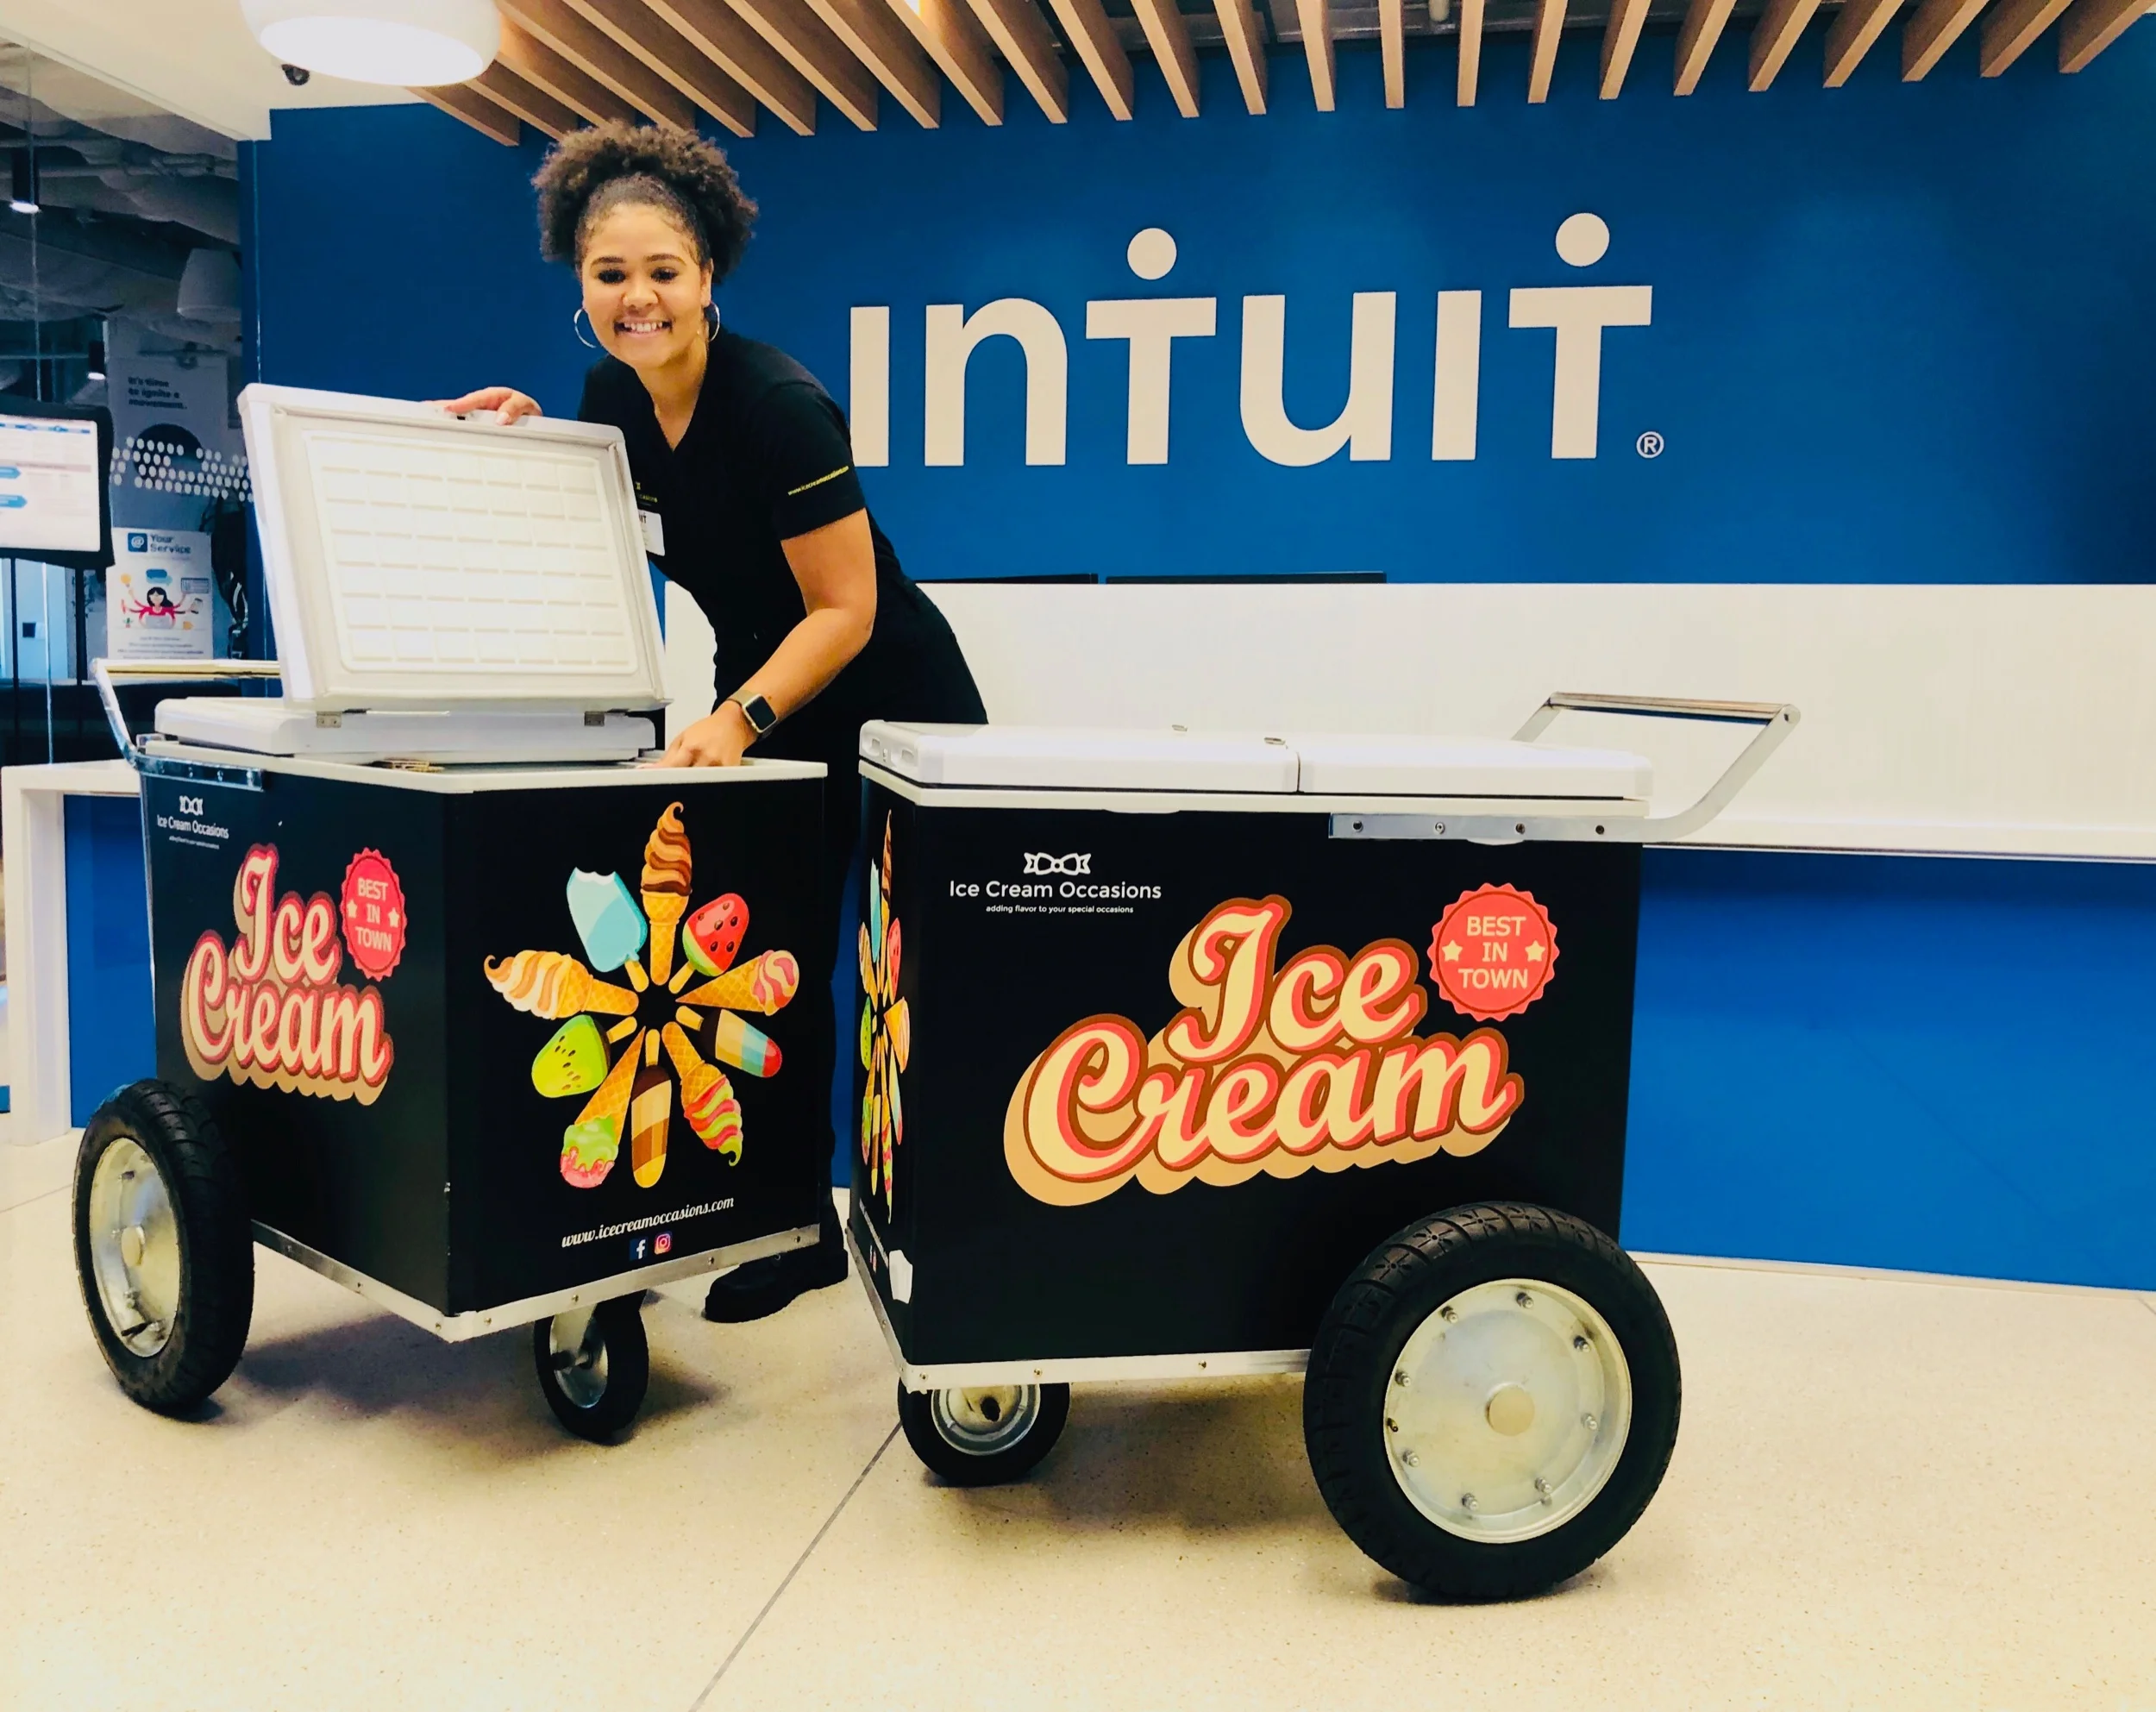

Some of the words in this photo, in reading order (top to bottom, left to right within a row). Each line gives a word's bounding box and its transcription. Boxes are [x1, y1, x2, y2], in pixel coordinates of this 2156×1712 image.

[850, 212, 1652, 467] intuit
[150, 534, 174, 543] Your
[150, 543, 191, 554] Service
[157, 814, 167, 828] Ice
[168, 816, 191, 832] Cream
[191, 820, 229, 839] Occasions
[358, 877, 389, 902] BEST
[950, 880, 980, 897] Ice
[986, 881, 1053, 898] Cream
[1059, 881, 1163, 900] Occasions
[234, 843, 342, 985] Ice
[367, 903, 381, 925] IN
[986, 905, 1013, 914] adding
[1049, 906, 1067, 914] your
[1068, 906, 1094, 914] special
[354, 925, 393, 953] TOWN
[1466, 915, 1527, 938] BEST
[1482, 941, 1508, 963] IN
[1163, 894, 1427, 1063] Ice
[1457, 968, 1529, 989] TOWN
[181, 929, 393, 1106] Cream
[1004, 1013, 1525, 1206] Cream
[561, 1197, 735, 1248] www.icecreamoccasions.com
